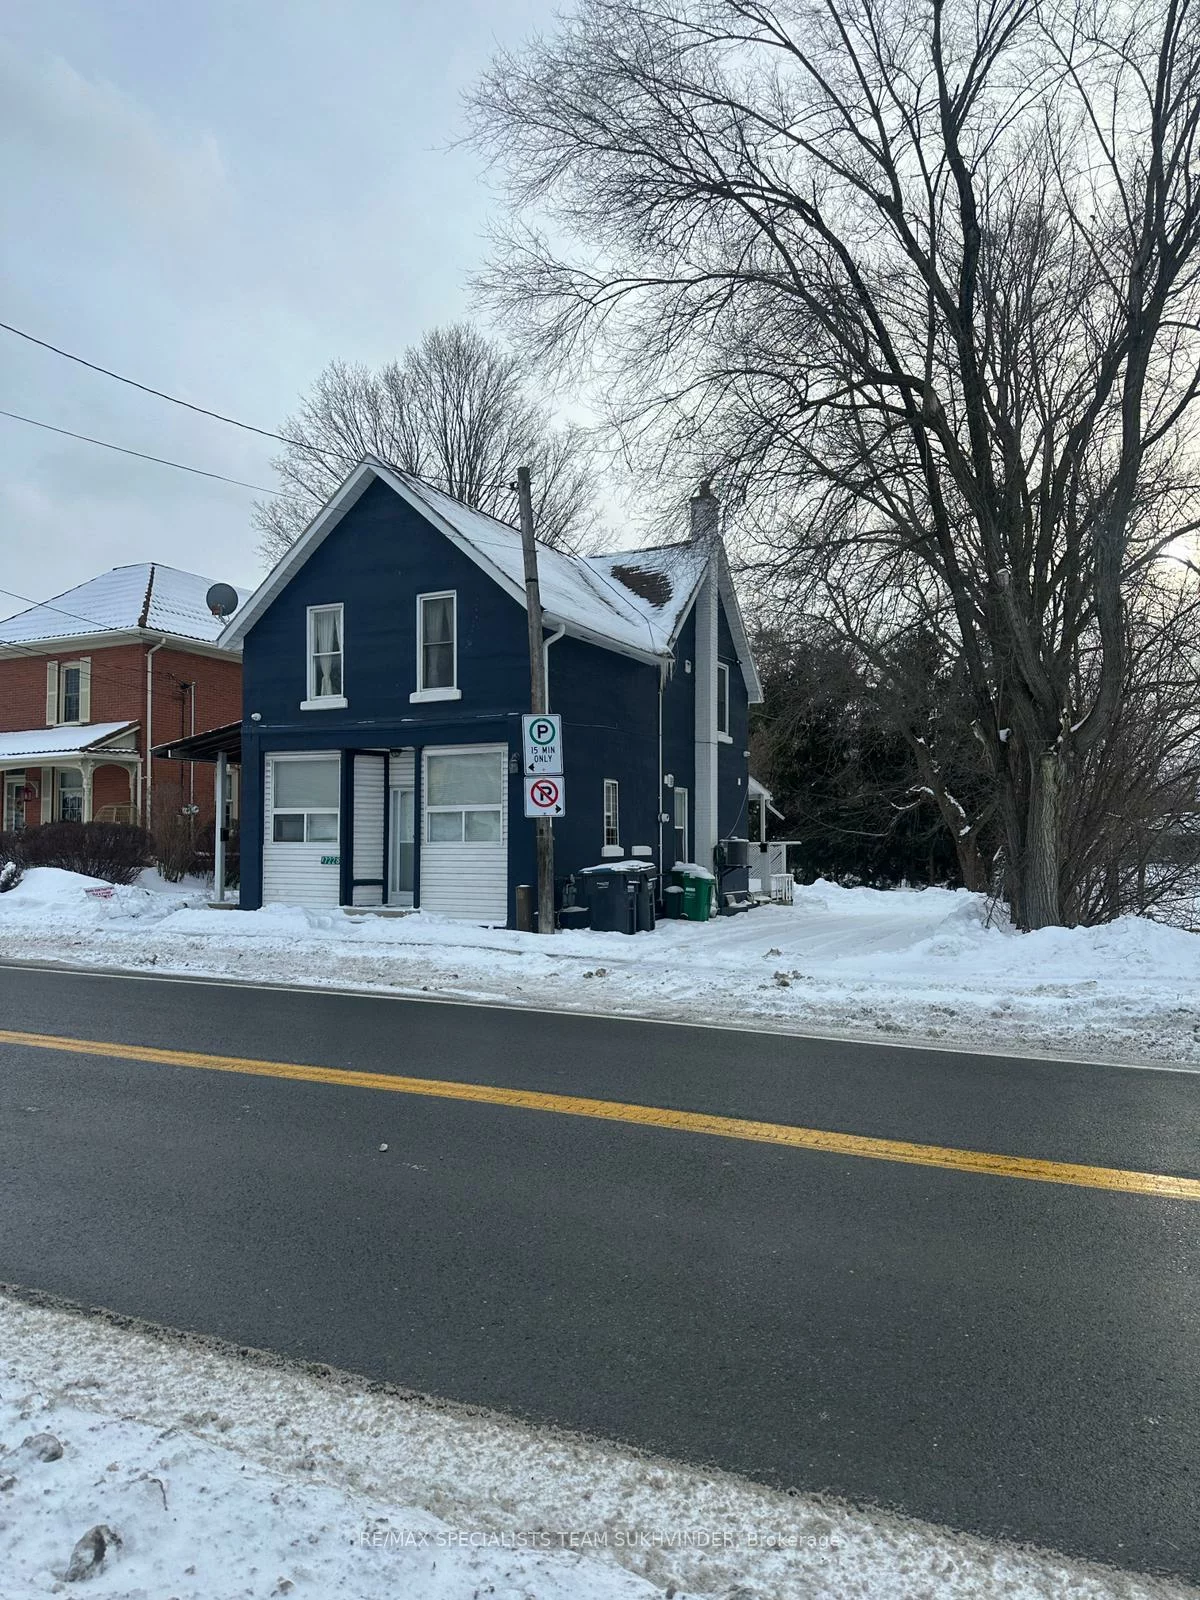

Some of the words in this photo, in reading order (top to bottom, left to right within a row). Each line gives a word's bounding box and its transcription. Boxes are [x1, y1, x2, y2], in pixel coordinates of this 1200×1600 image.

[537, 724, 549, 739] P
[531, 746, 539, 754] 15
[542, 746, 556, 754] MIN
[534, 754, 553, 763] ONLY
[540, 786, 553, 801] P
